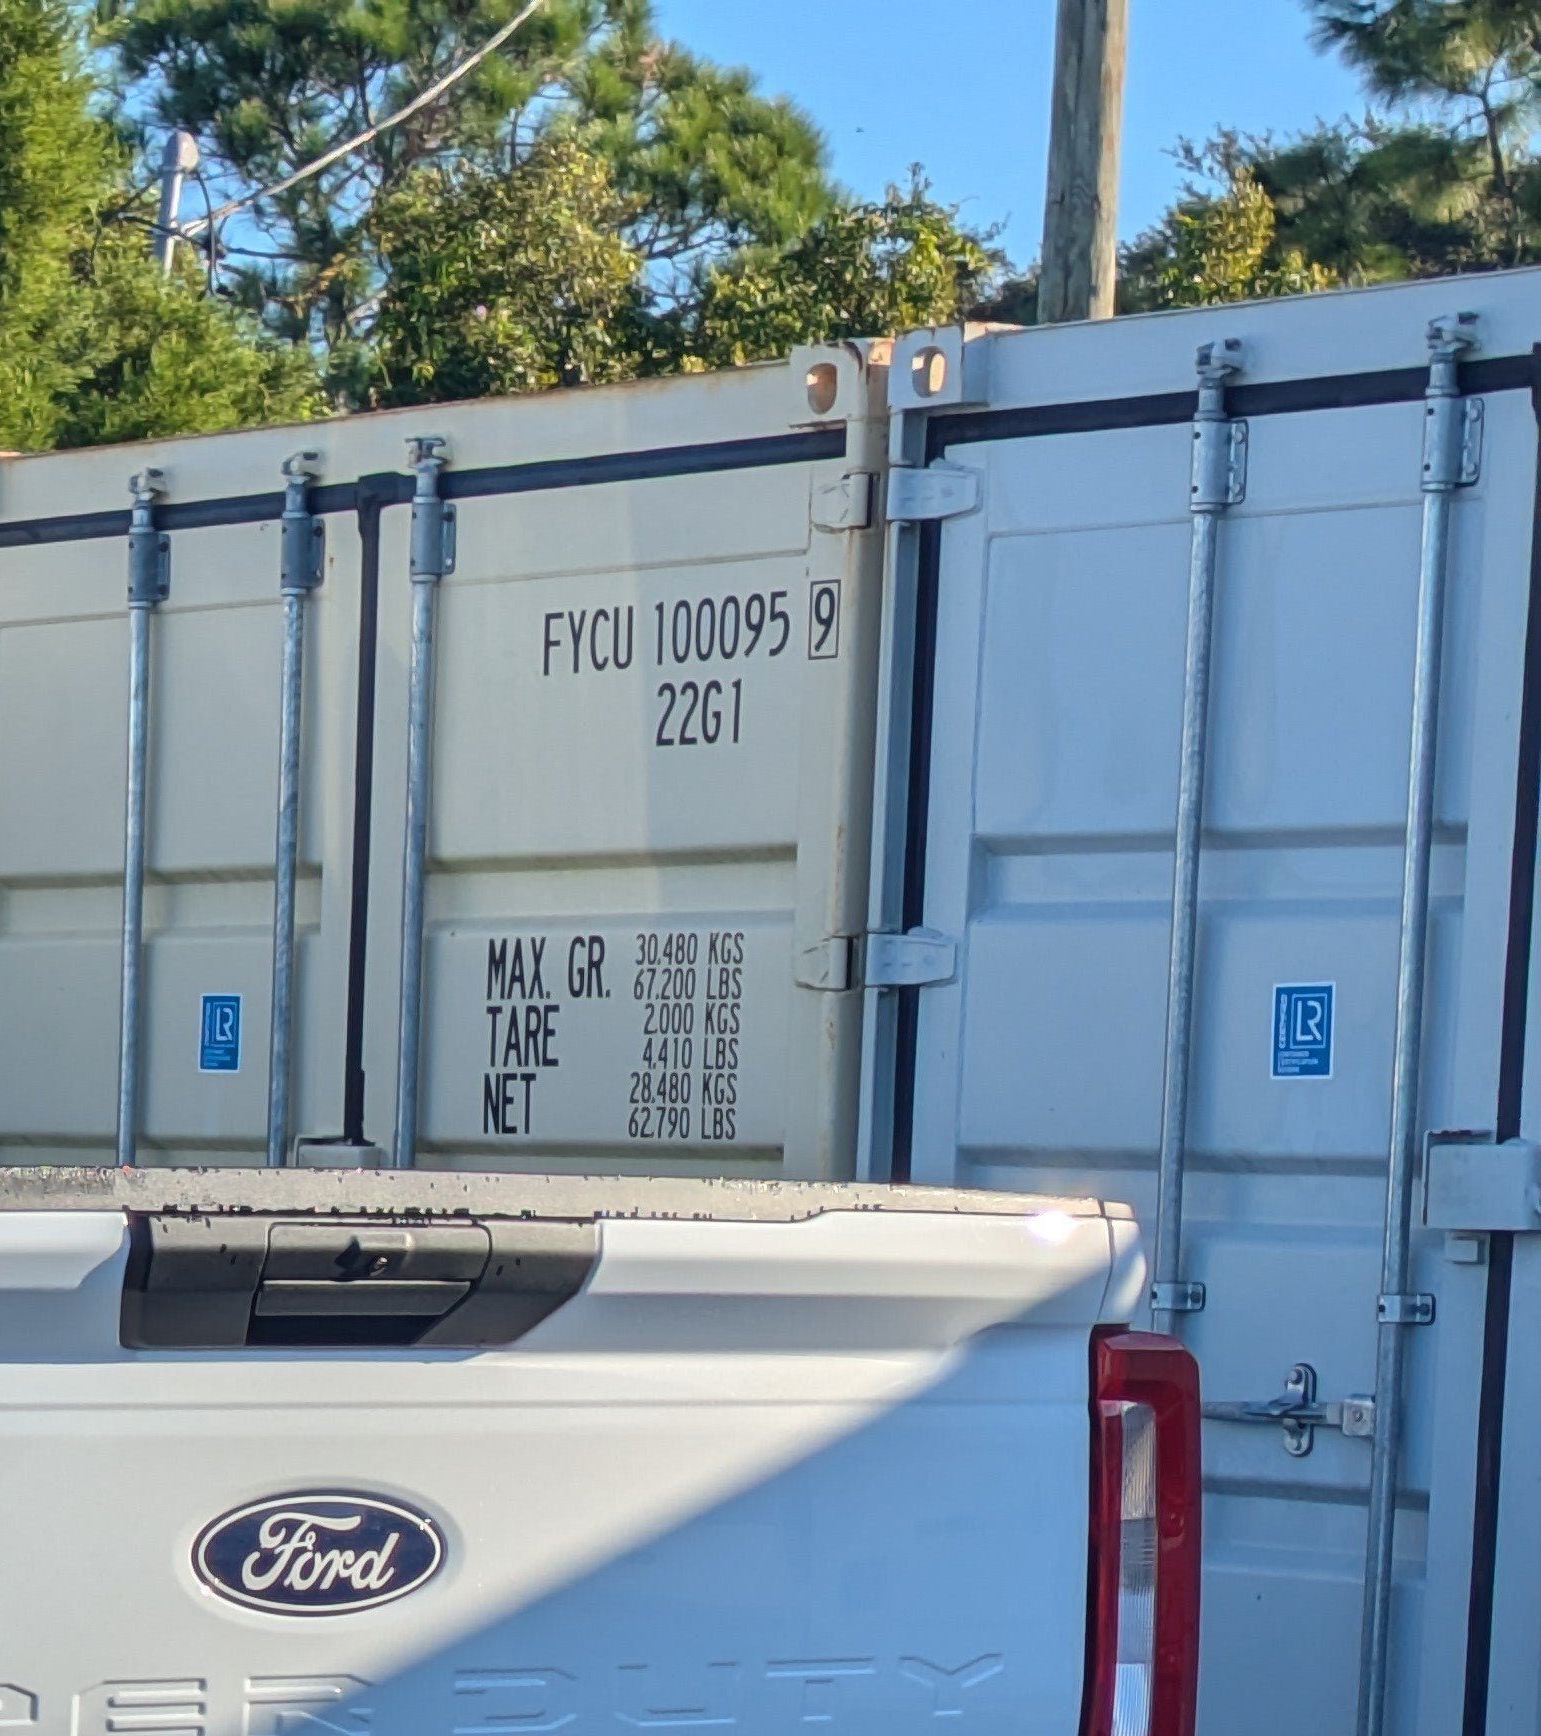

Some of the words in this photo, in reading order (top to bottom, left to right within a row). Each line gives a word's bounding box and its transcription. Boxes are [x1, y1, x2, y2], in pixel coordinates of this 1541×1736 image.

[543, 604, 634, 676] FYCU
[654, 590, 791, 666] 100095
[812, 585, 837, 654] 9
[655, 677, 742, 747] 22G1
[486, 936, 551, 1000] MAX.
[567, 934, 611, 999] GR.
[707, 931, 745, 966] KGS
[706, 966, 743, 1001] LBS
[485, 1004, 561, 1068] TARE
[704, 1002, 742, 1036] KGS
[1295, 999, 1323, 1042] LR
[702, 1037, 739, 1070] LBS
[482, 1072, 537, 1135] NET
[701, 1072, 738, 1106] KGS
[700, 1107, 737, 1141] LBS
[241, 1511, 402, 1592] Ford
[452, 1652, 1004, 1736] DUTY
